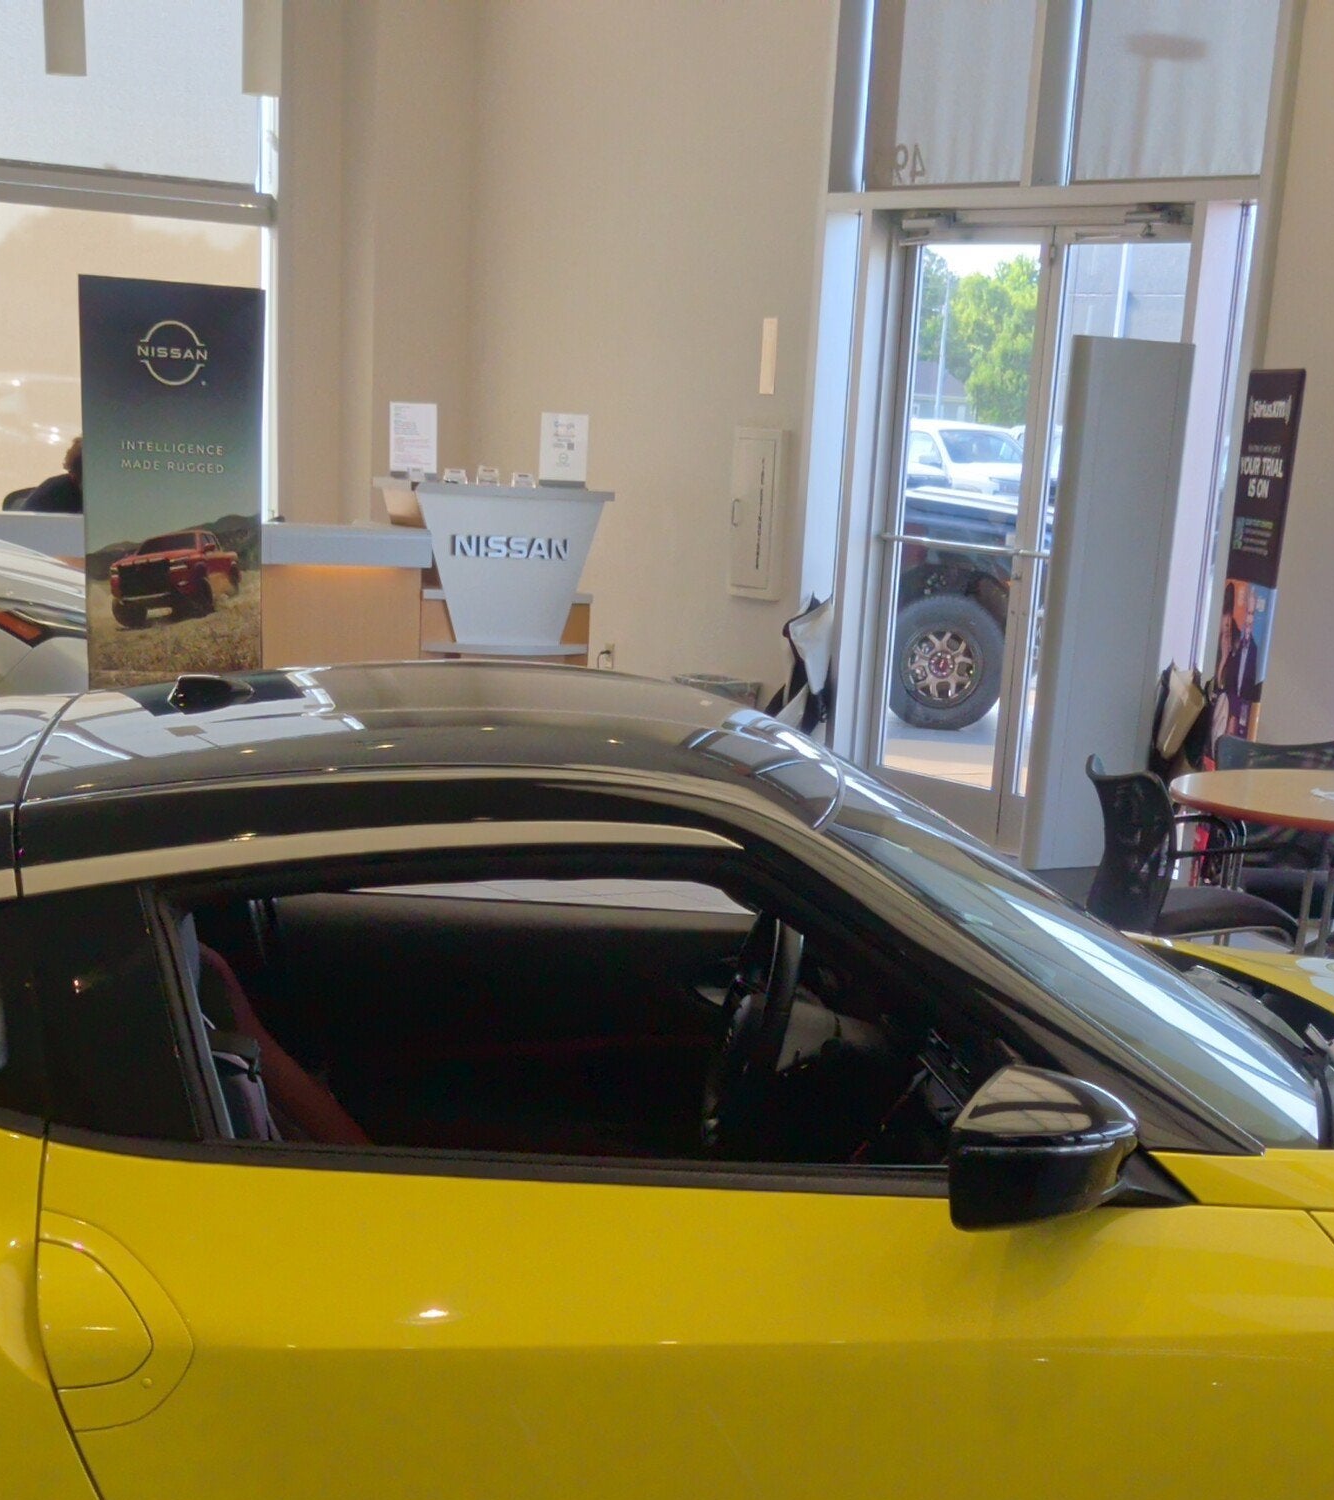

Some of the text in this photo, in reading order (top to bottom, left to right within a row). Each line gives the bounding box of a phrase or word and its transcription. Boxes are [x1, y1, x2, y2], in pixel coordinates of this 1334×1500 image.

[137, 345, 208, 361] NISSAN
[121, 440, 224, 456] INTELLIGENCE
[121, 459, 225, 474] MADE RUGGED
[1240, 456, 1284, 479] YOUR TRIAL
[1247, 478, 1270, 499] IS ON
[451, 534, 570, 561] NISSAN
